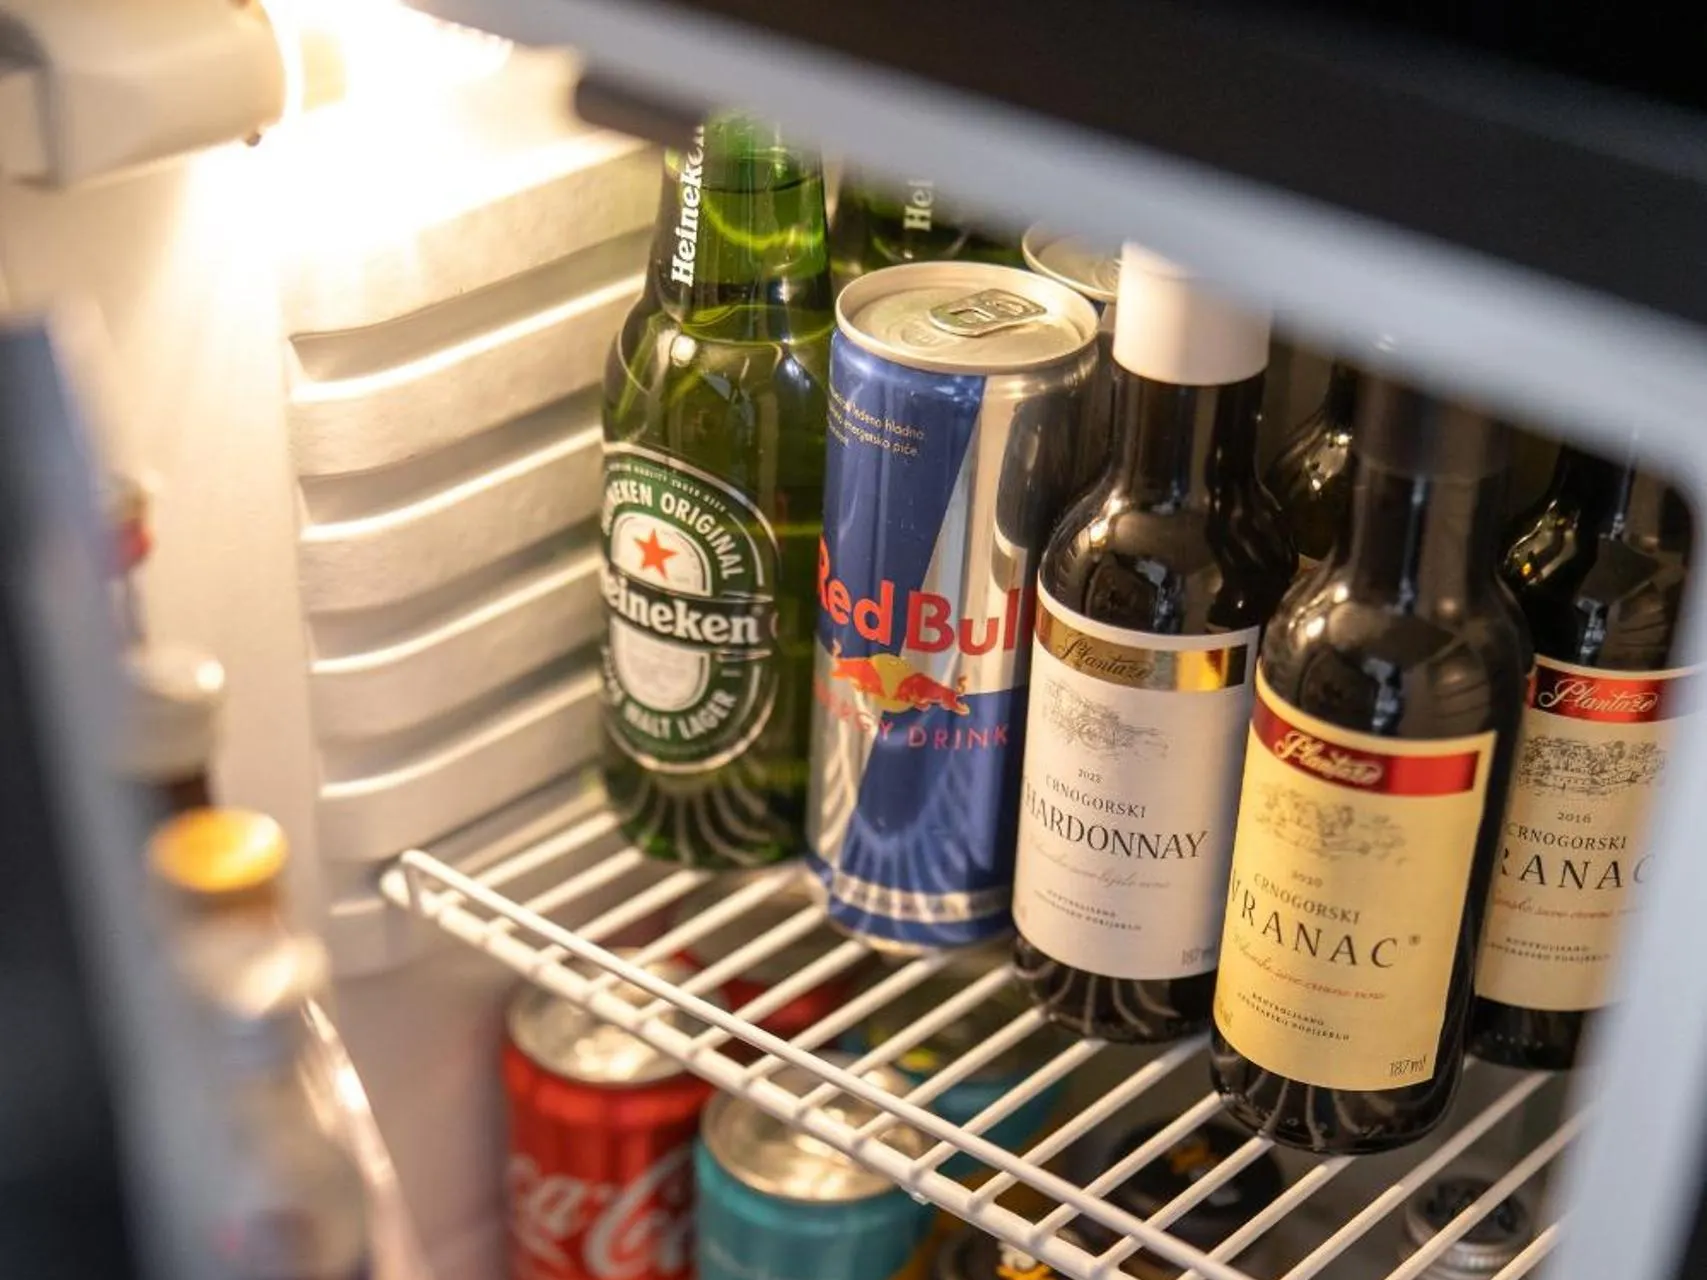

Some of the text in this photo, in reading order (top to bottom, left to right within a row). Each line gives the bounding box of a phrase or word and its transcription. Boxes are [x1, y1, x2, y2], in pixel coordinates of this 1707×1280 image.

[659, 491, 745, 580] ORIGINAL
[817, 534, 895, 648] Red
[908, 724, 1008, 750] DRINK
[1026, 782, 1208, 861] HARDONNAY
[1253, 872, 1361, 926] CRNOGORSKI
